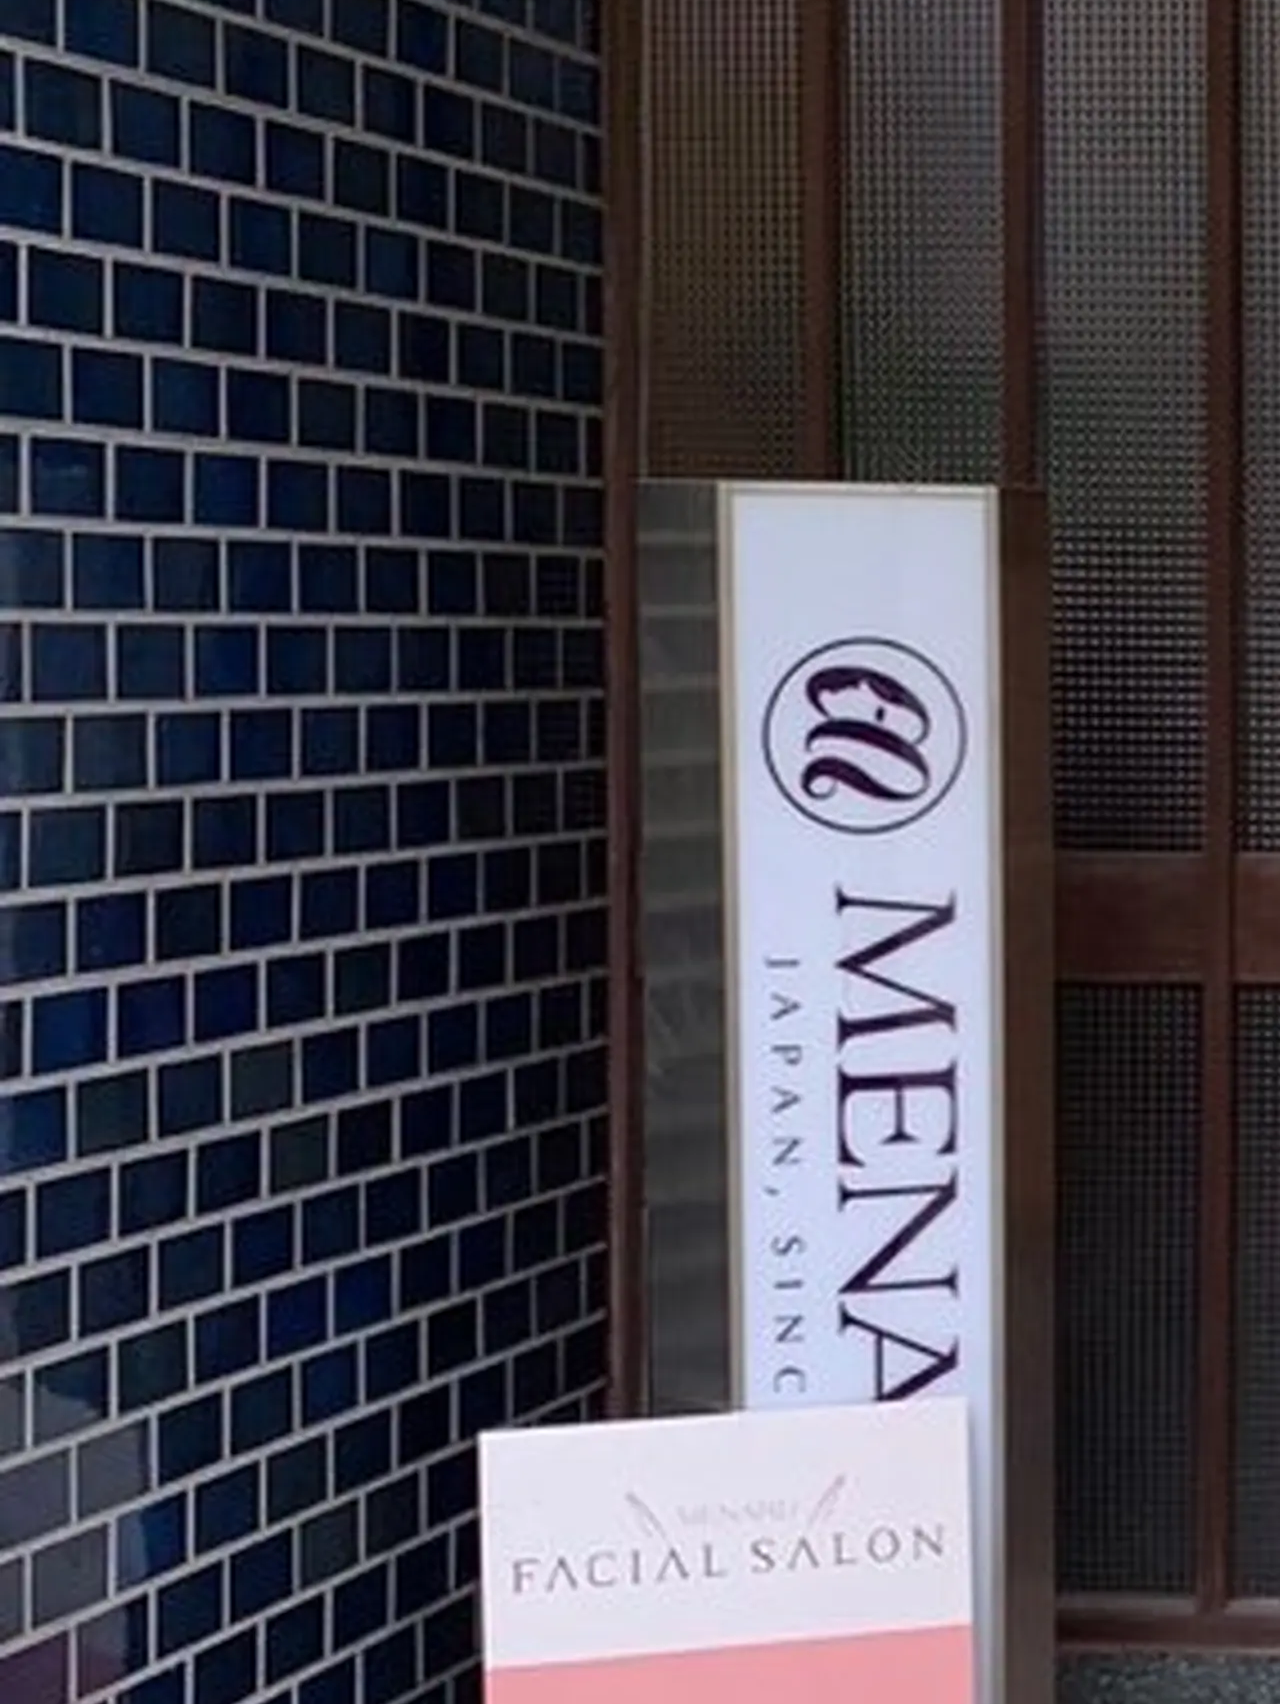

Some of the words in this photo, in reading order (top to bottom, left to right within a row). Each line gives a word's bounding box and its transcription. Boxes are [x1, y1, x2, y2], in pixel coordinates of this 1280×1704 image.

[763, 955, 803, 1197] JAPAN,
[511, 1540, 728, 1595] FACIAL
[751, 1524, 946, 1575] SALON
